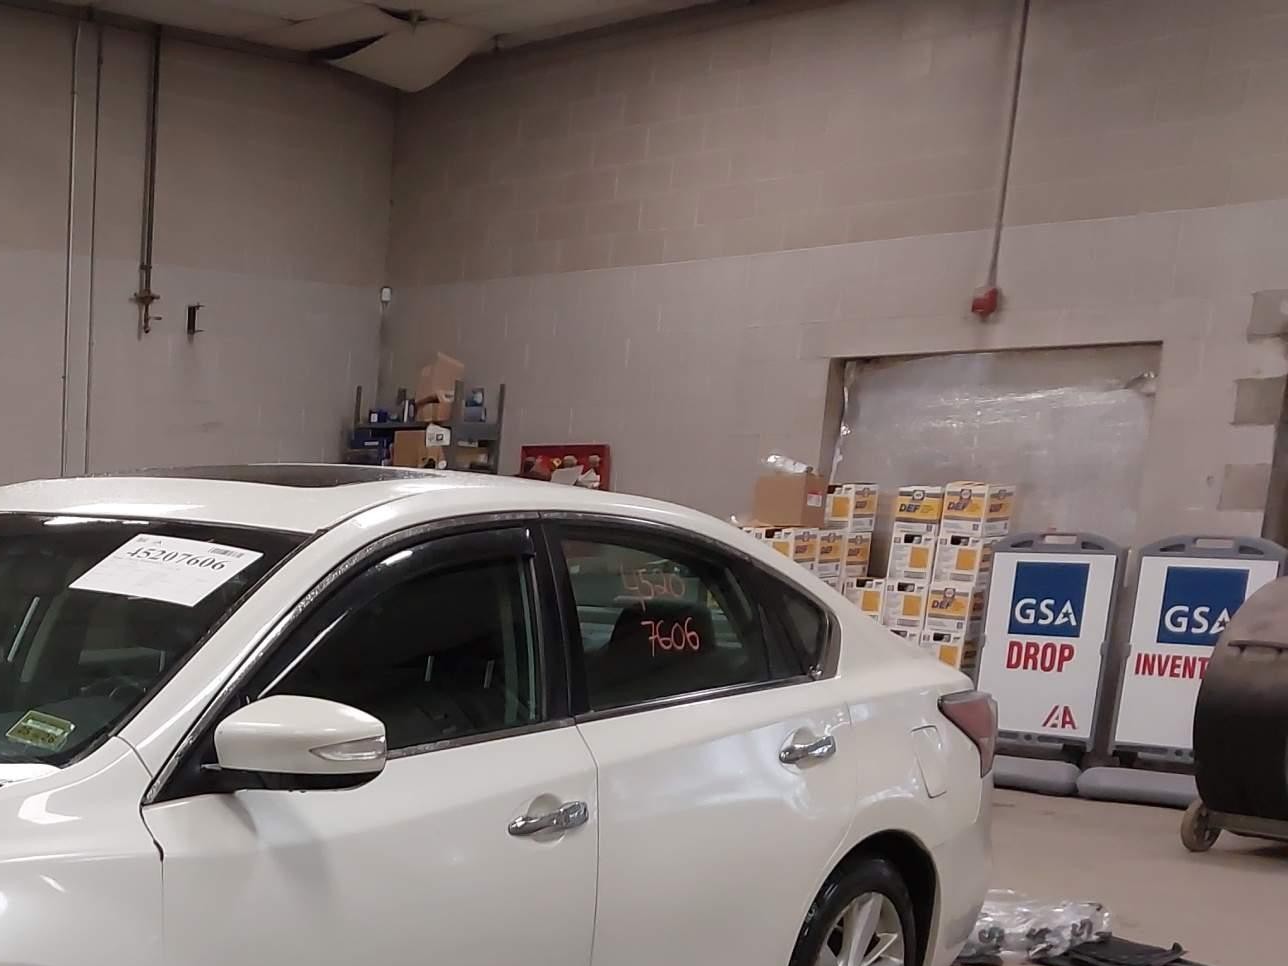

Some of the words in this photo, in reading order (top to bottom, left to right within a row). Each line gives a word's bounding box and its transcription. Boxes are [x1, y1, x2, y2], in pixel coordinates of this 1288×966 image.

[899, 503, 921, 513] DEF
[947, 501, 969, 511] DEF
[127, 547, 229, 571] 45207606
[931, 600, 952, 609] DEF
[1014, 598, 1078, 626] GSA
[1164, 605, 1231, 634] GSA
[641, 616, 700, 657] 7606
[1006, 640, 1076, 672] DROP
